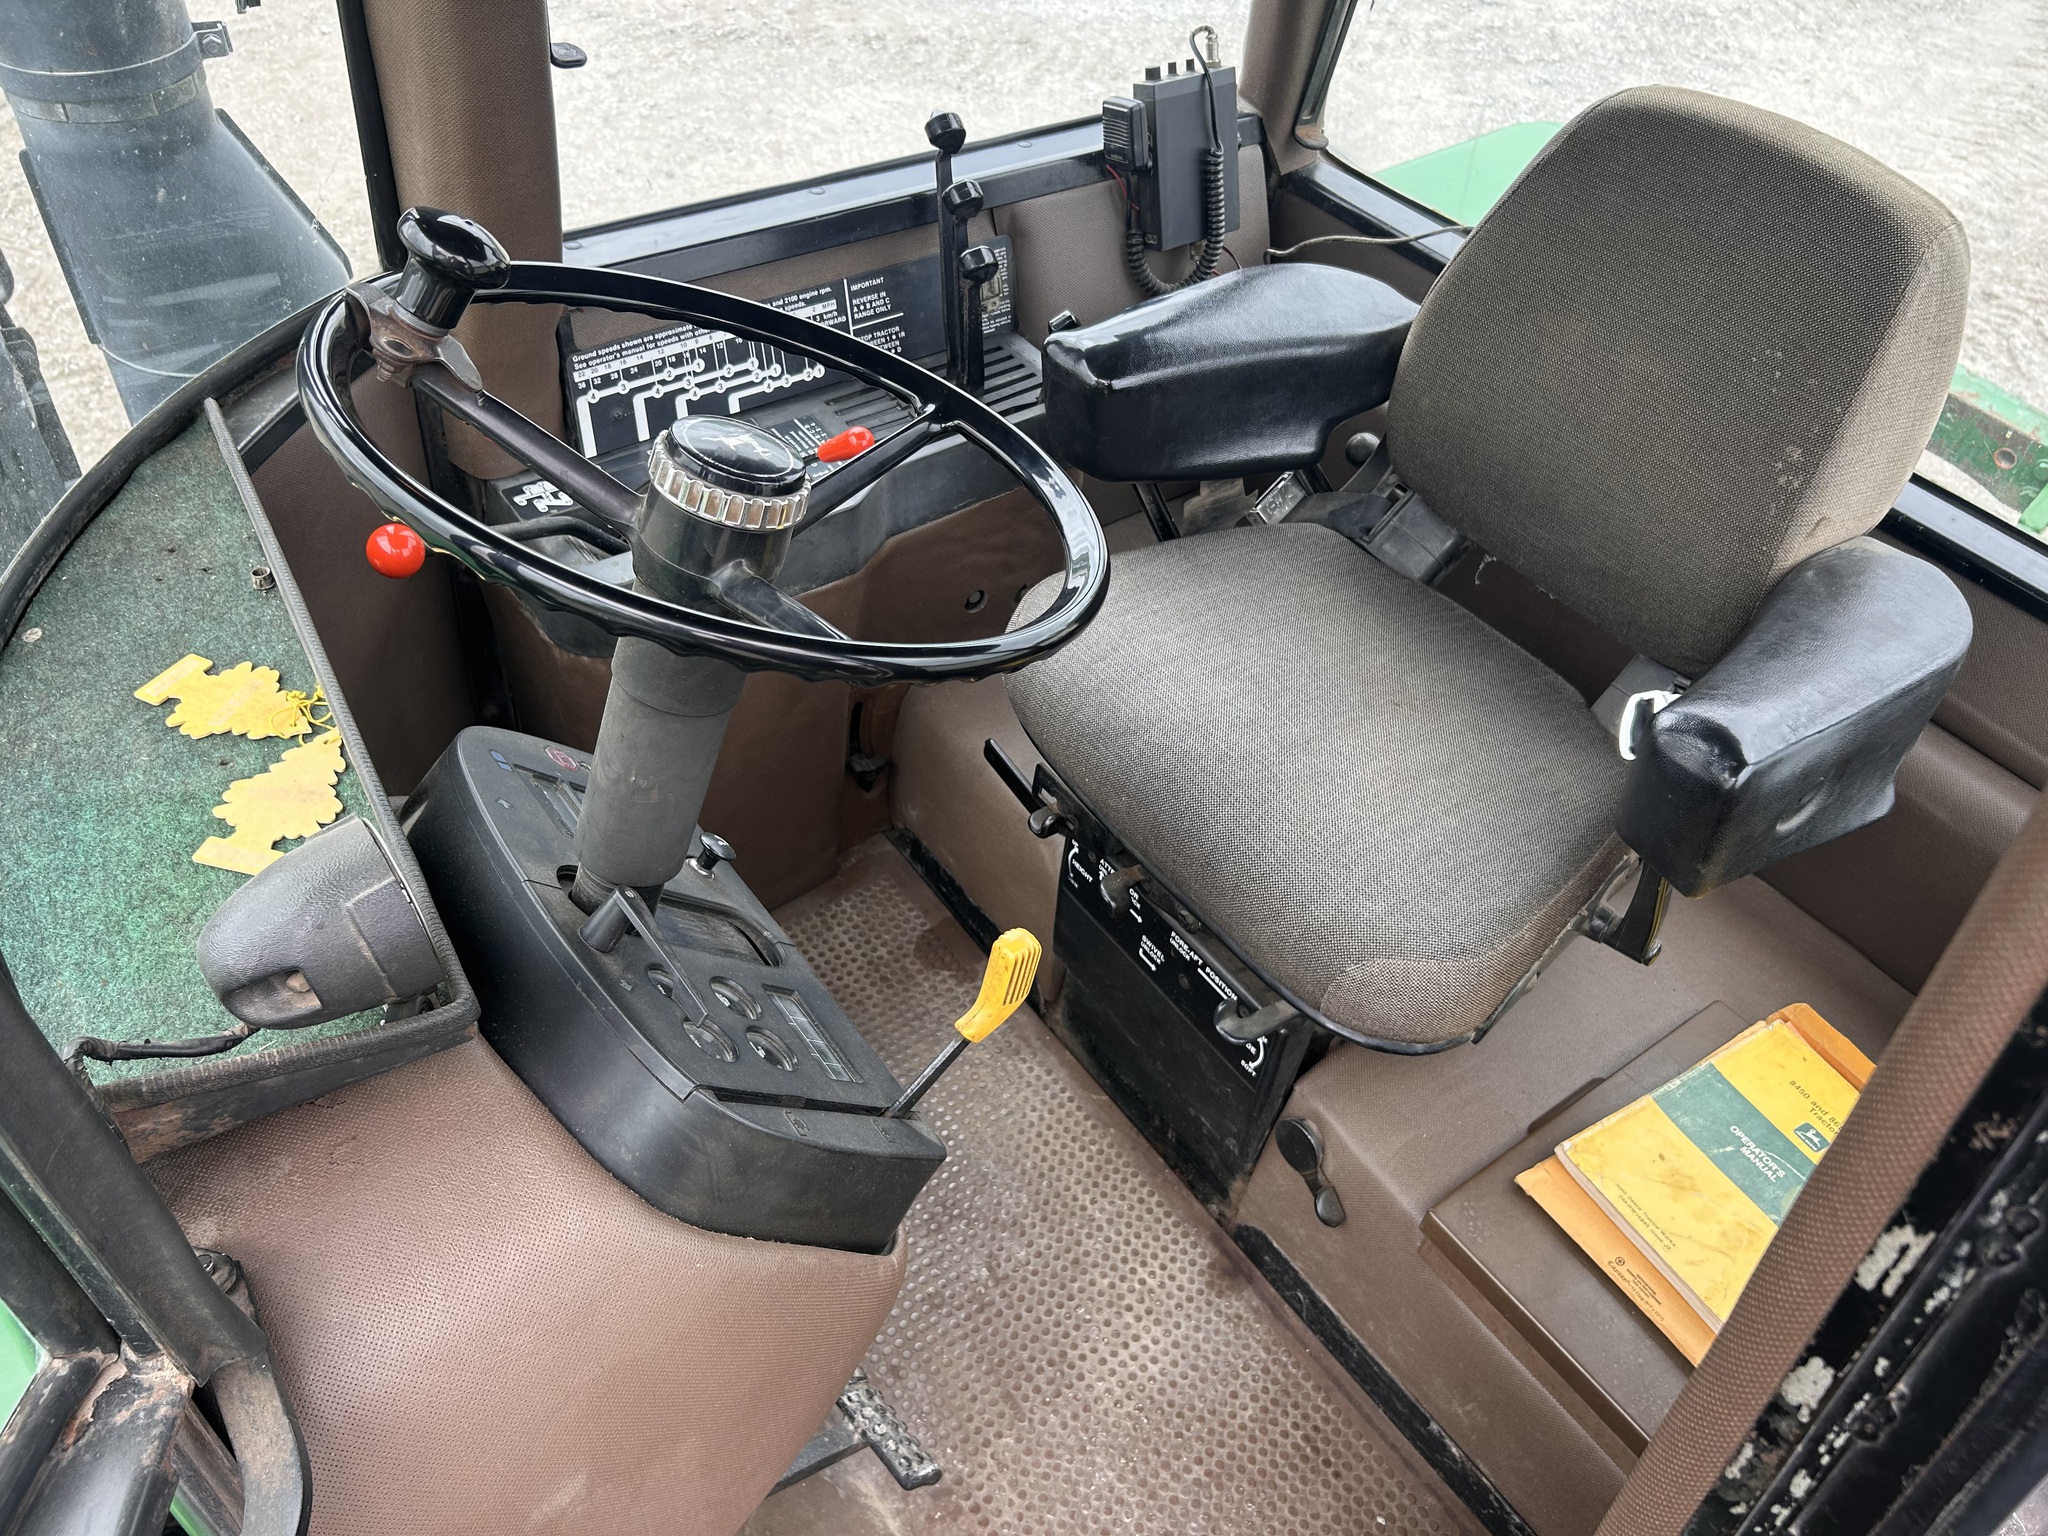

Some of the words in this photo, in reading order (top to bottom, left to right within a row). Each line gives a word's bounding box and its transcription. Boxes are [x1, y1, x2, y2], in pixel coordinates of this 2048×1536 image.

[850, 277, 884, 291] IMPORTANT
[772, 299, 784, 307] and
[784, 295, 798, 304] 2100
[799, 291, 818, 300] engine
[819, 287, 832, 295] rpm.
[821, 301, 835, 309] MPH
[852, 293, 879, 306] REVERSE
[871, 299, 885, 308] AND
[785, 301, 807, 312] speeds.
[854, 308, 875, 320] RANGE
[875, 304, 891, 314] ONLY
[820, 315, 847, 327] ORWARD
[857, 334, 873, 342] TOP
[873, 326, 900, 339] TRACTOR
[572, 350, 597, 363] Ground
[597, 344, 621, 356] speeds
[621, 338, 643, 349] shown
[643, 334, 654, 343] are
[654, 324, 693, 340] approximate
[573, 362, 587, 371] See
[588, 353, 621, 367] operator's
[621, 344, 646, 357] manual
[646, 342, 656, 350] for
[656, 335, 680, 347] speeds
[679, 331, 694, 340] with
[577, 381, 587, 390] 36
[593, 377, 602, 385] 32
[609, 372, 619, 380] 28
[629, 366, 639, 375] 24
[654, 359, 663, 367] 20
[668, 355, 676, 363] 18
[715, 342, 724, 350] 12
[823, 311, 838, 320] km/h
[655, 387, 660, 395] 4
[686, 378, 691, 386] 3
[784, 377, 790, 385] 3
[806, 370, 812, 378] 2
[621, 383, 627, 391] 3
[692, 390, 697, 398] 4
[718, 382, 723, 390] 3
[1072, 858, 1093, 883] HEIGHT
[1140, 941, 1162, 965] UNLOCK
[1141, 935, 1166, 962] SWIVEL
[1169, 937, 1191, 962] UNLOCK
[1170, 931, 1204, 966] FORE-AFT
[1205, 966, 1238, 1001] POSITION
[1789, 1080, 1811, 1100] 8450
[1810, 1100, 1829, 1117] and
[1730, 1125, 1786, 1178] OPERATOR'S
[1740, 1145, 1777, 1183] MANUAL
